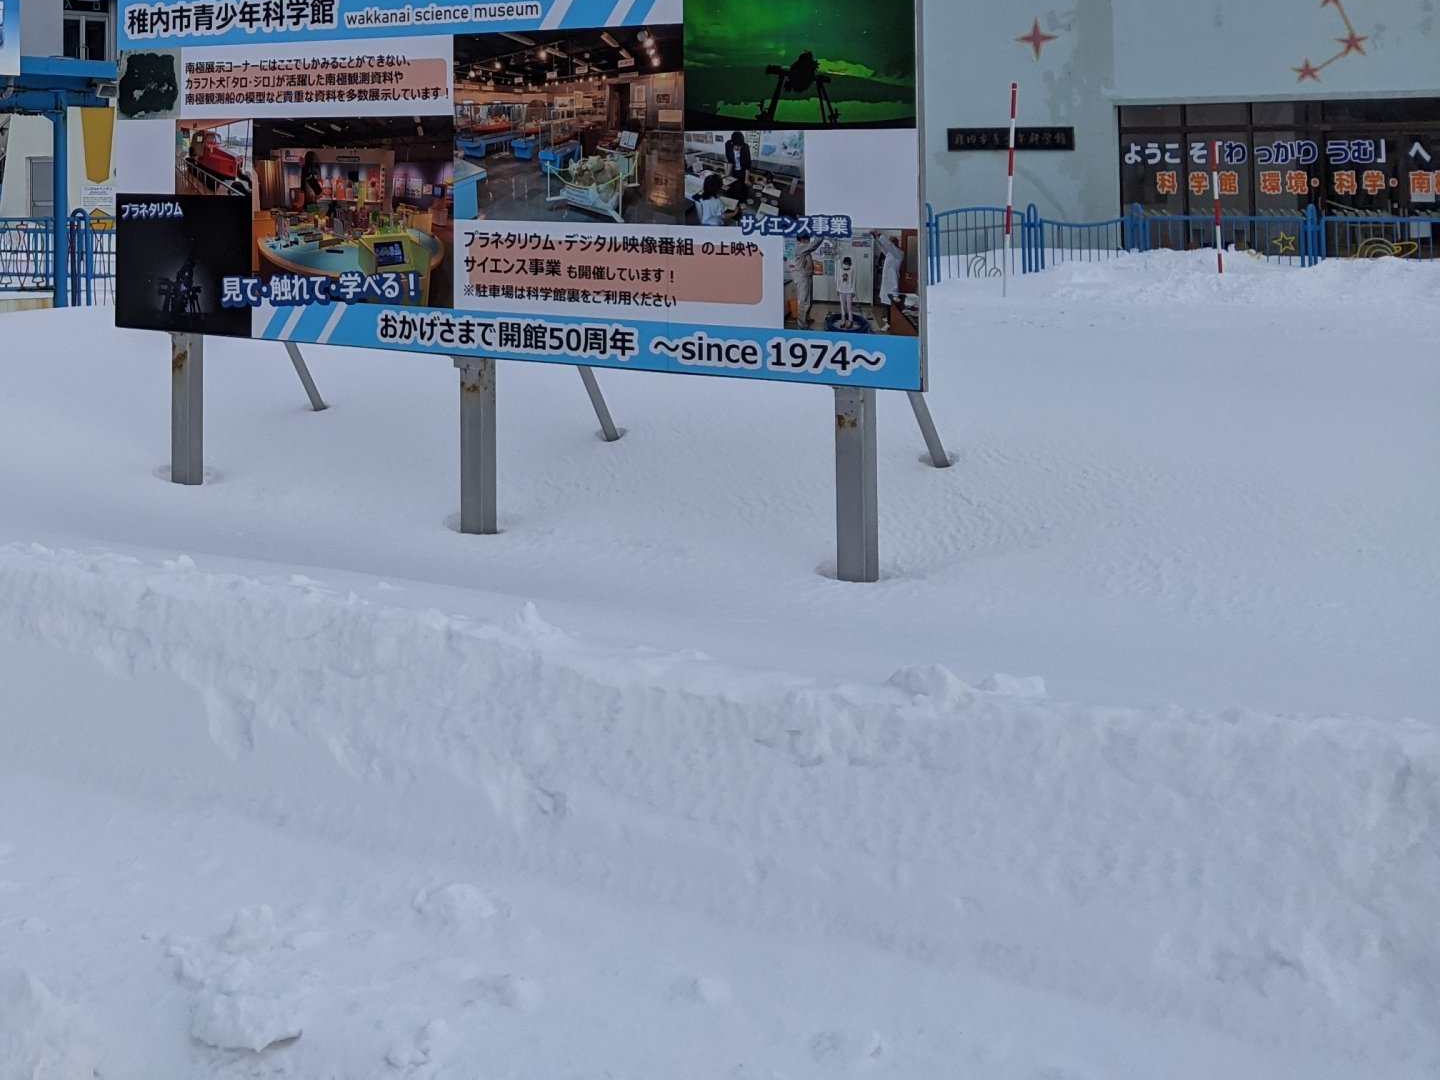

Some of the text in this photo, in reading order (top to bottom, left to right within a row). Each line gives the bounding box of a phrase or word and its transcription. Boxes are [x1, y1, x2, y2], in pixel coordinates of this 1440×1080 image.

[346, 3, 539, 25] wakkanai science museum
[185, 55, 411, 75] 南極展示コーナーにはここでしかみることができない、
[1156, 170, 1440, 195] 科学館 環境・科学・南
[121, 202, 183, 217] プラネタリウム
[741, 216, 849, 235] サイエンス事業
[464, 231, 764, 257] プラネタリウム・デジタル映像番組 の上映や、
[464, 256, 674, 284] サイエンス事業 も開催しています！
[222, 273, 415, 301] 見て・触れて・学べる！
[463, 284, 677, 308] ※駐車場は科学館裏をご利用ください
[380, 314, 635, 356] おかげさまで開館50周年
